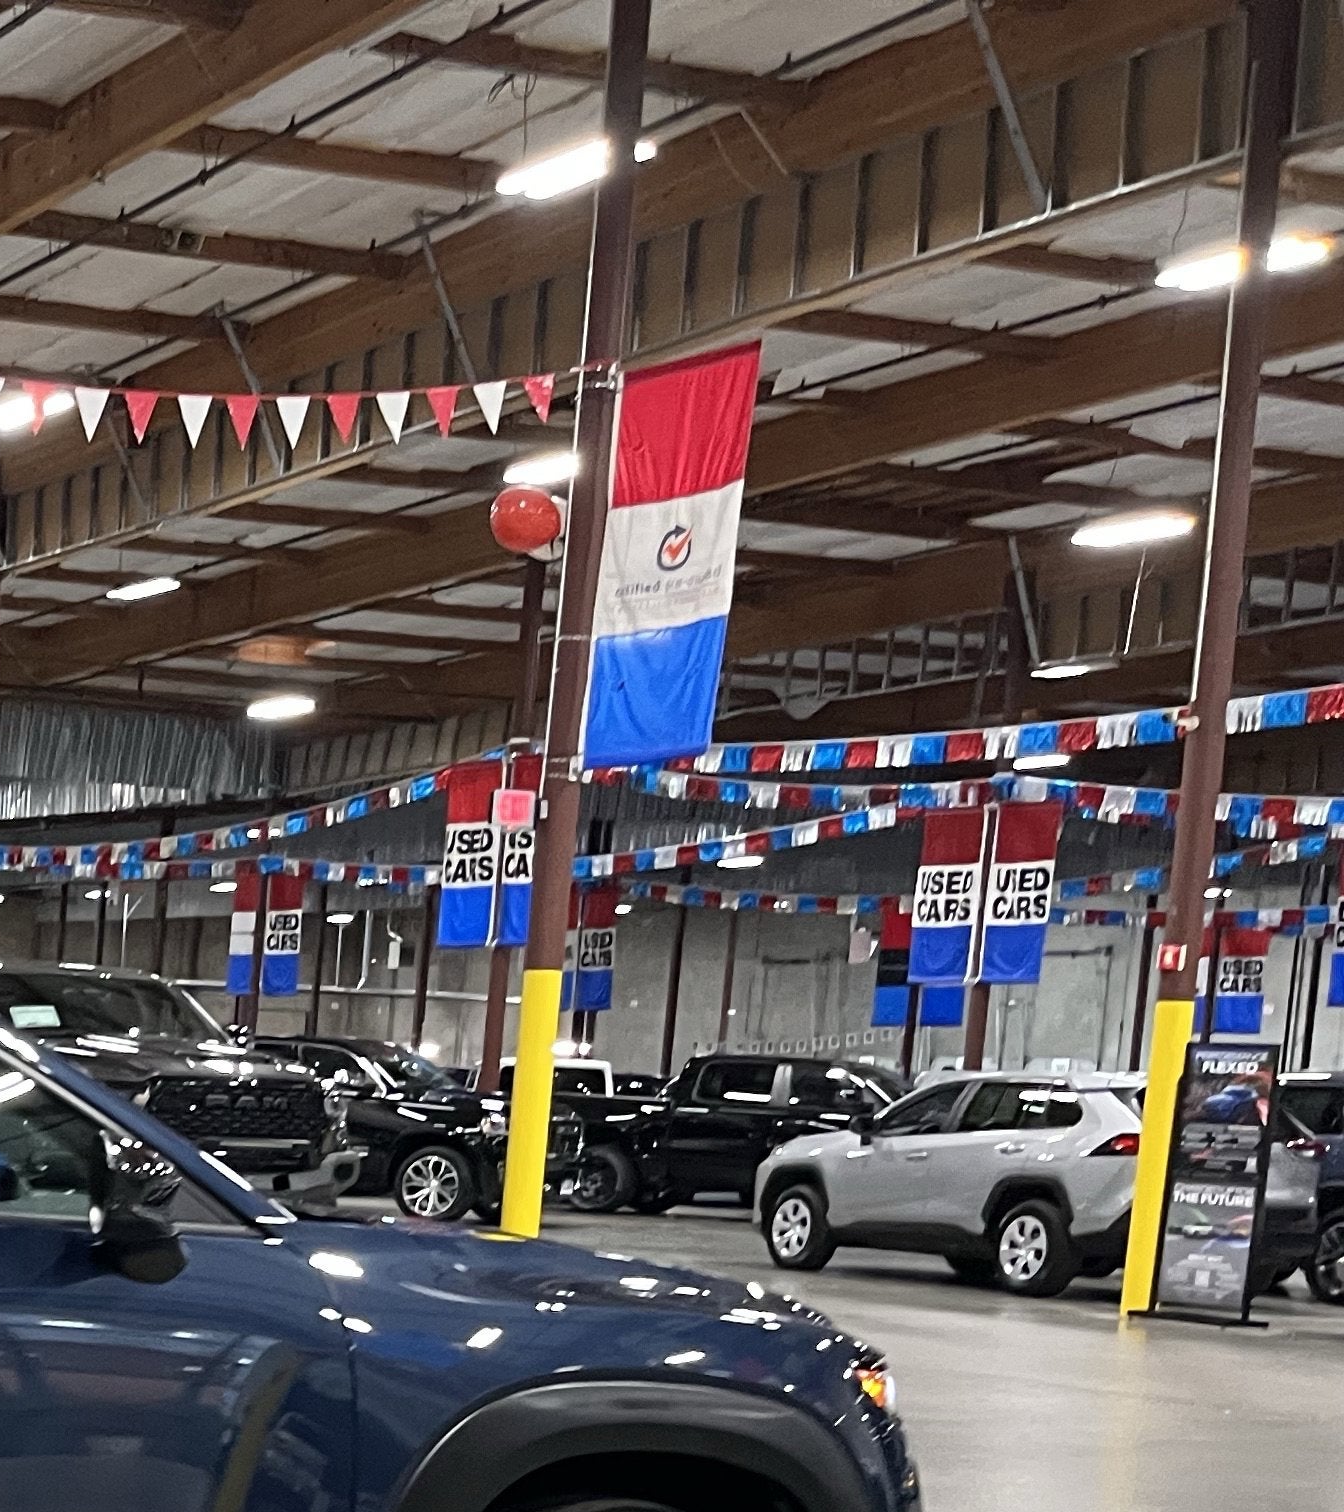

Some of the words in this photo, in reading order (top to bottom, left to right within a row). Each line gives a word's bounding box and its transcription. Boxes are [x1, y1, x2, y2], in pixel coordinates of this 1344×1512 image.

[920, 870, 974, 896] USED
[917, 898, 972, 923] CARS
[1223, 960, 1263, 976] USED
[1219, 977, 1262, 993] CARS
